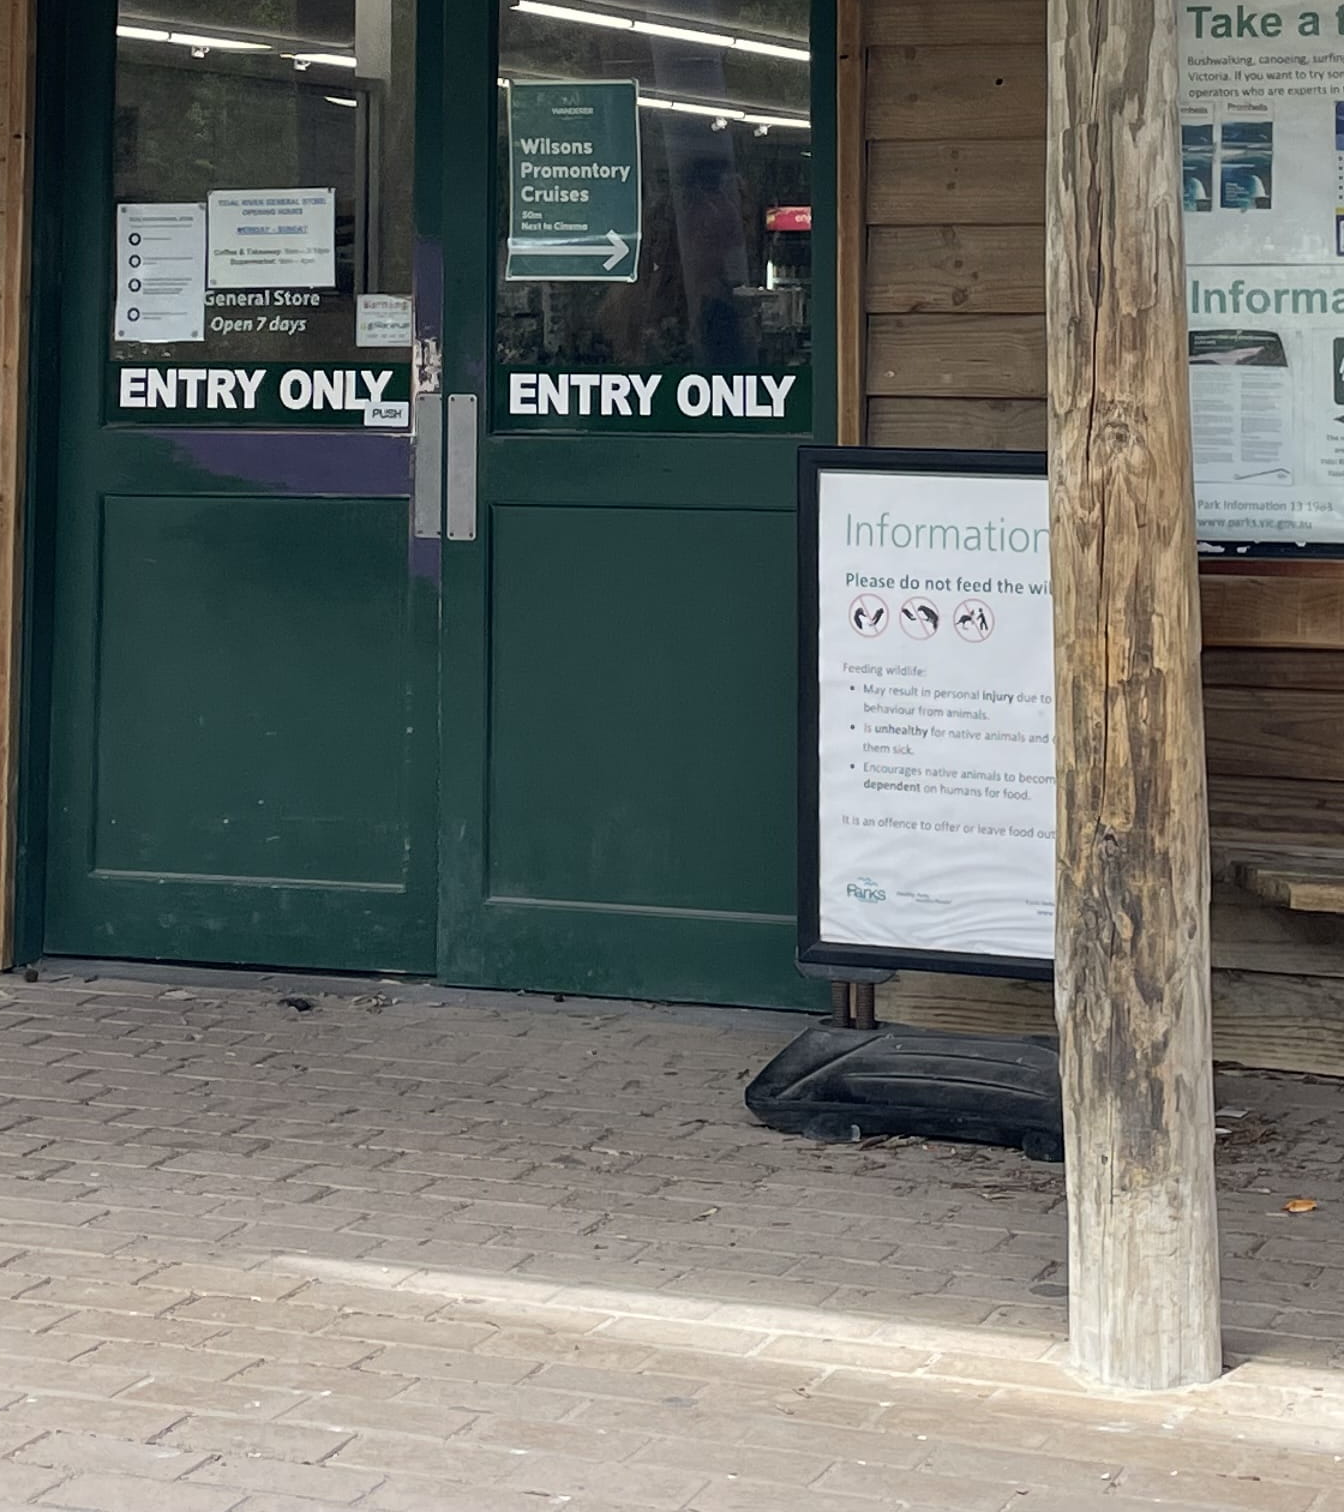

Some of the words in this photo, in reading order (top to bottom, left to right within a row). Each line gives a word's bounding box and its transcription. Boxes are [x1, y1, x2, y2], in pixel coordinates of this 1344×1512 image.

[1186, 4, 1283, 39] Take
[1297, 10, 1320, 37] a
[1244, 72, 1263, 83] you
[1266, 70, 1293, 80] want
[1295, 69, 1306, 80] to
[1309, 69, 1325, 82] try
[520, 137, 593, 155] Wilsons
[520, 162, 631, 183] Promontory
[521, 185, 590, 202] Cruises
[521, 222, 542, 231] Next
[204, 289, 270, 307] General
[274, 289, 320, 307] Store
[210, 317, 253, 334] Open
[256, 317, 266, 332] 7
[269, 316, 307, 337] days
[119, 368, 267, 409] ENTRY
[279, 369, 393, 410] ONLY
[509, 372, 662, 416] ENTRY
[676, 373, 796, 418] ONLY
[372, 408, 402, 419] PUSH
[846, 511, 1050, 554] Information
[845, 572, 895, 589] Please
[899, 574, 920, 590] do
[924, 577, 951, 592] not
[956, 576, 992, 594] feed
[997, 579, 1025, 595] the
[842, 662, 883, 677] Feeding
[863, 683, 886, 697] May
[888, 686, 918, 697] result
[933, 688, 980, 701] personal
[982, 690, 1015, 704] injury
[1016, 692, 1037, 703] due
[1040, 694, 1053, 705] to
[863, 702, 916, 716] behaviour
[918, 705, 944, 717] from
[874, 723, 928, 739] unhealthy
[930, 726, 946, 738] for
[948, 729, 982, 741] native
[984, 731, 1026, 743] animals
[1028, 733, 1049, 744] and
[862, 742, 891, 753] them
[863, 761, 922, 777] Encourages
[924, 767, 958, 778] native
[960, 770, 1002, 782] animals
[863, 778, 921, 792] dependent
[940, 784, 983, 798] humans
[984, 787, 1000, 799] for
[877, 817, 917, 831] offence
[977, 824, 1006, 837] leave
[1008, 826, 1034, 839] food
